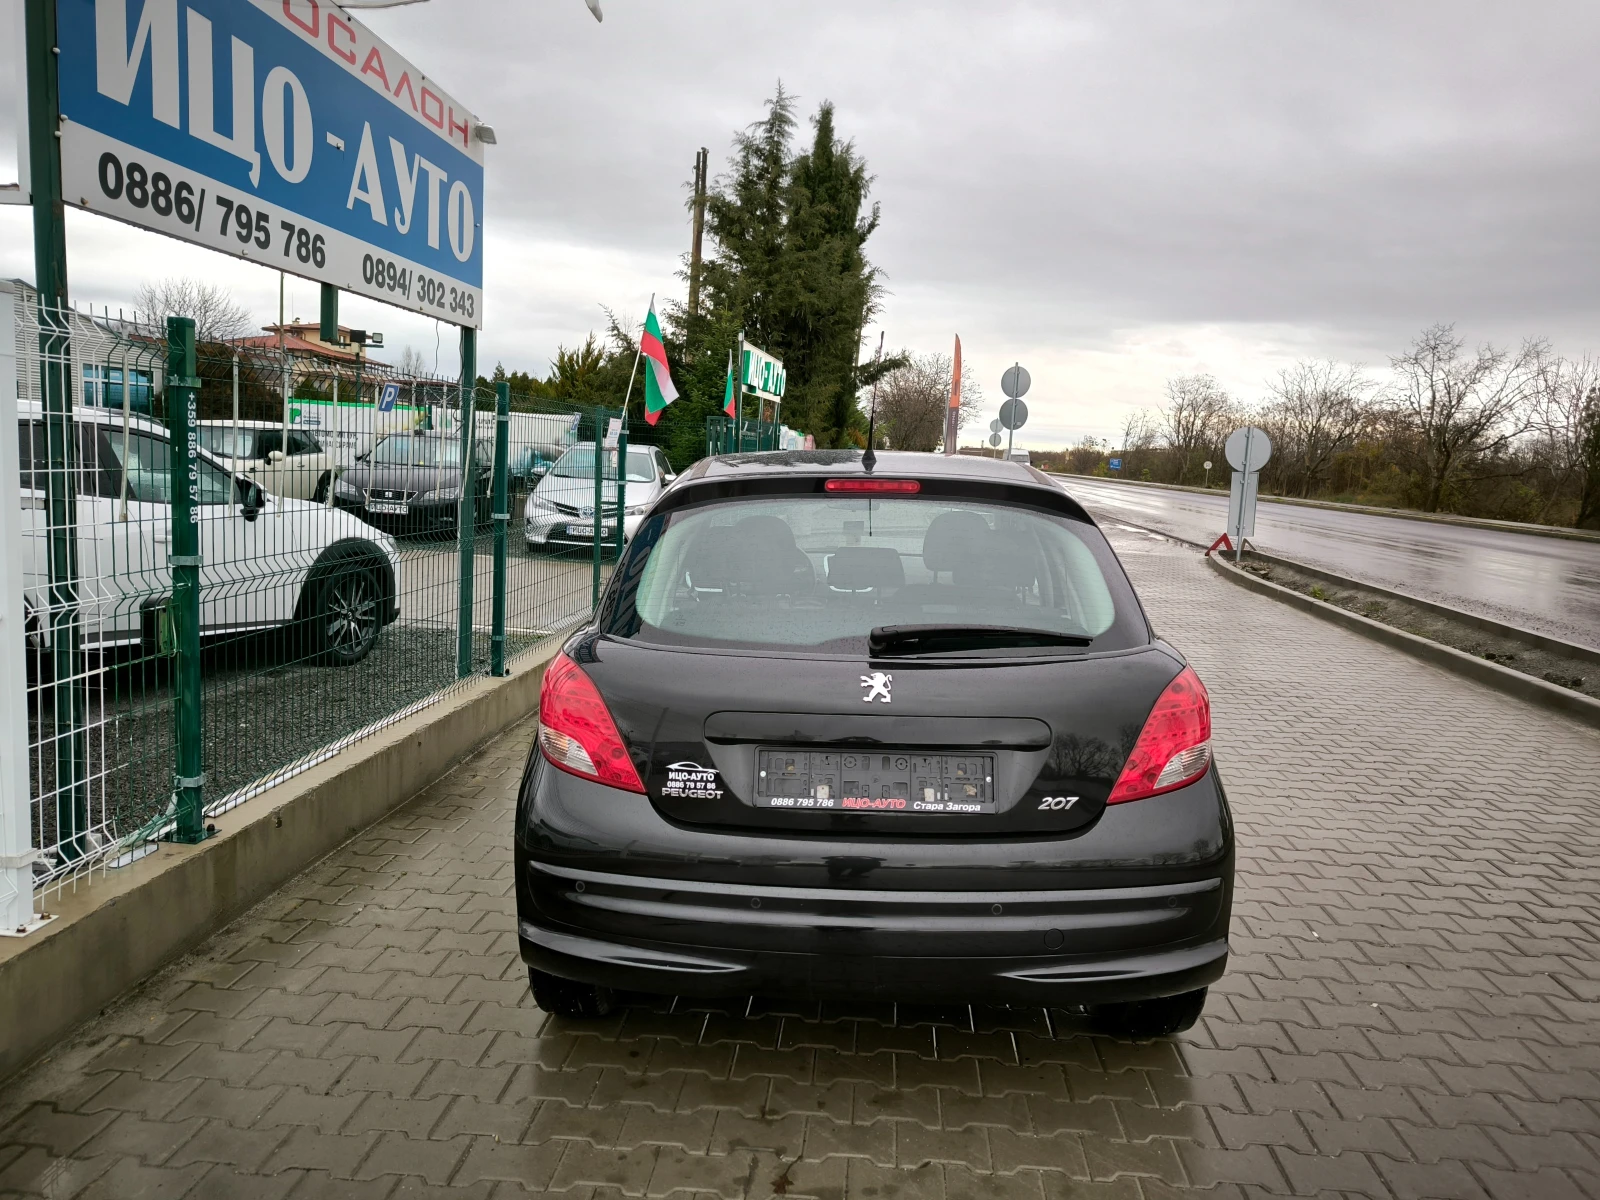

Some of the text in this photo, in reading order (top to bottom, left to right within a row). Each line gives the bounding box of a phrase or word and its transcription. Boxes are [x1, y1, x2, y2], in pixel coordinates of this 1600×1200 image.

[98, 152, 326, 269] 0886/ 795 786
[362, 253, 474, 318] 0894/ 302 343
[382, 387, 395, 409] P
[187, 391, 199, 524] +359 886 79 57 86
[668, 771, 715, 782] ИЦО-АУТО
[661, 787, 724, 799] PEUGEOT
[771, 798, 834, 807] 0886 795 786
[841, 797, 907, 809] ИЦО-АУТО
[913, 801, 981, 812] Стара Загора
[1037, 796, 1080, 810] 207
